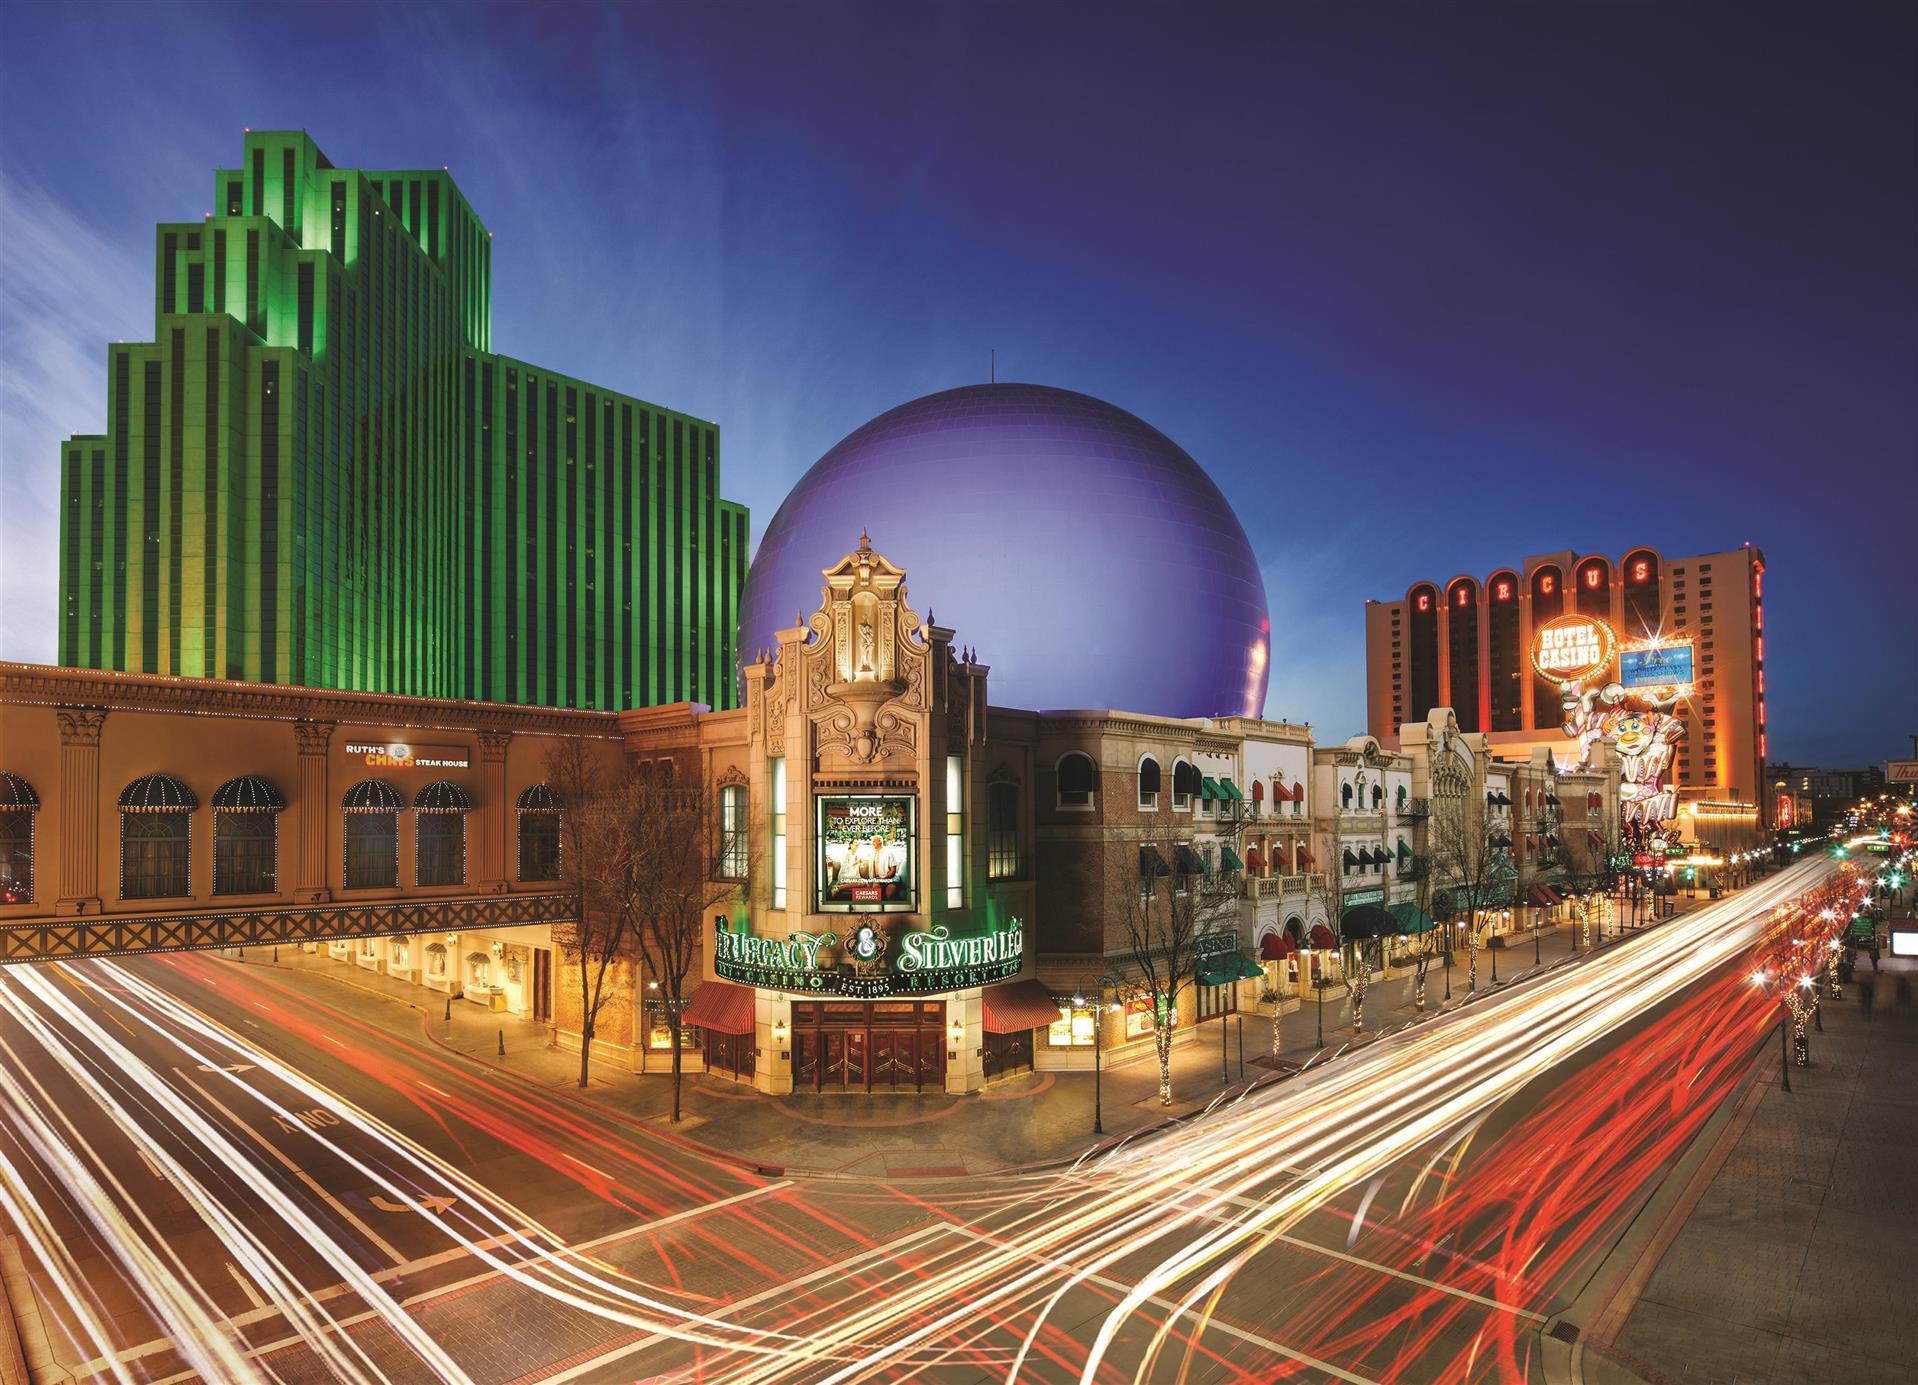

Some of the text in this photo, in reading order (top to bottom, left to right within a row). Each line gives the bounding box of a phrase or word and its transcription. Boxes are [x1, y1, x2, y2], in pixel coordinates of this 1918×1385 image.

[1419, 563, 1646, 610] CIRCUS
[1541, 625, 1599, 649] HOTEL
[1539, 645, 1600, 669] CASINO
[346, 745, 385, 755] RUTH'S
[416, 759, 441, 767] STEAK
[442, 760, 468, 768] HOUSE
[833, 817, 899, 825] TO EXPLORE THAN
[849, 806, 883, 817] MORE
[731, 931, 837, 969] LEGACY
[858, 928, 876, 957] &
[898, 925, 998, 972] SILVER
[745, 971, 823, 988] CASINO
[841, 983, 863, 995] EST.
[867, 984, 890, 995] 1895
[910, 964, 988, 988] RESORT
